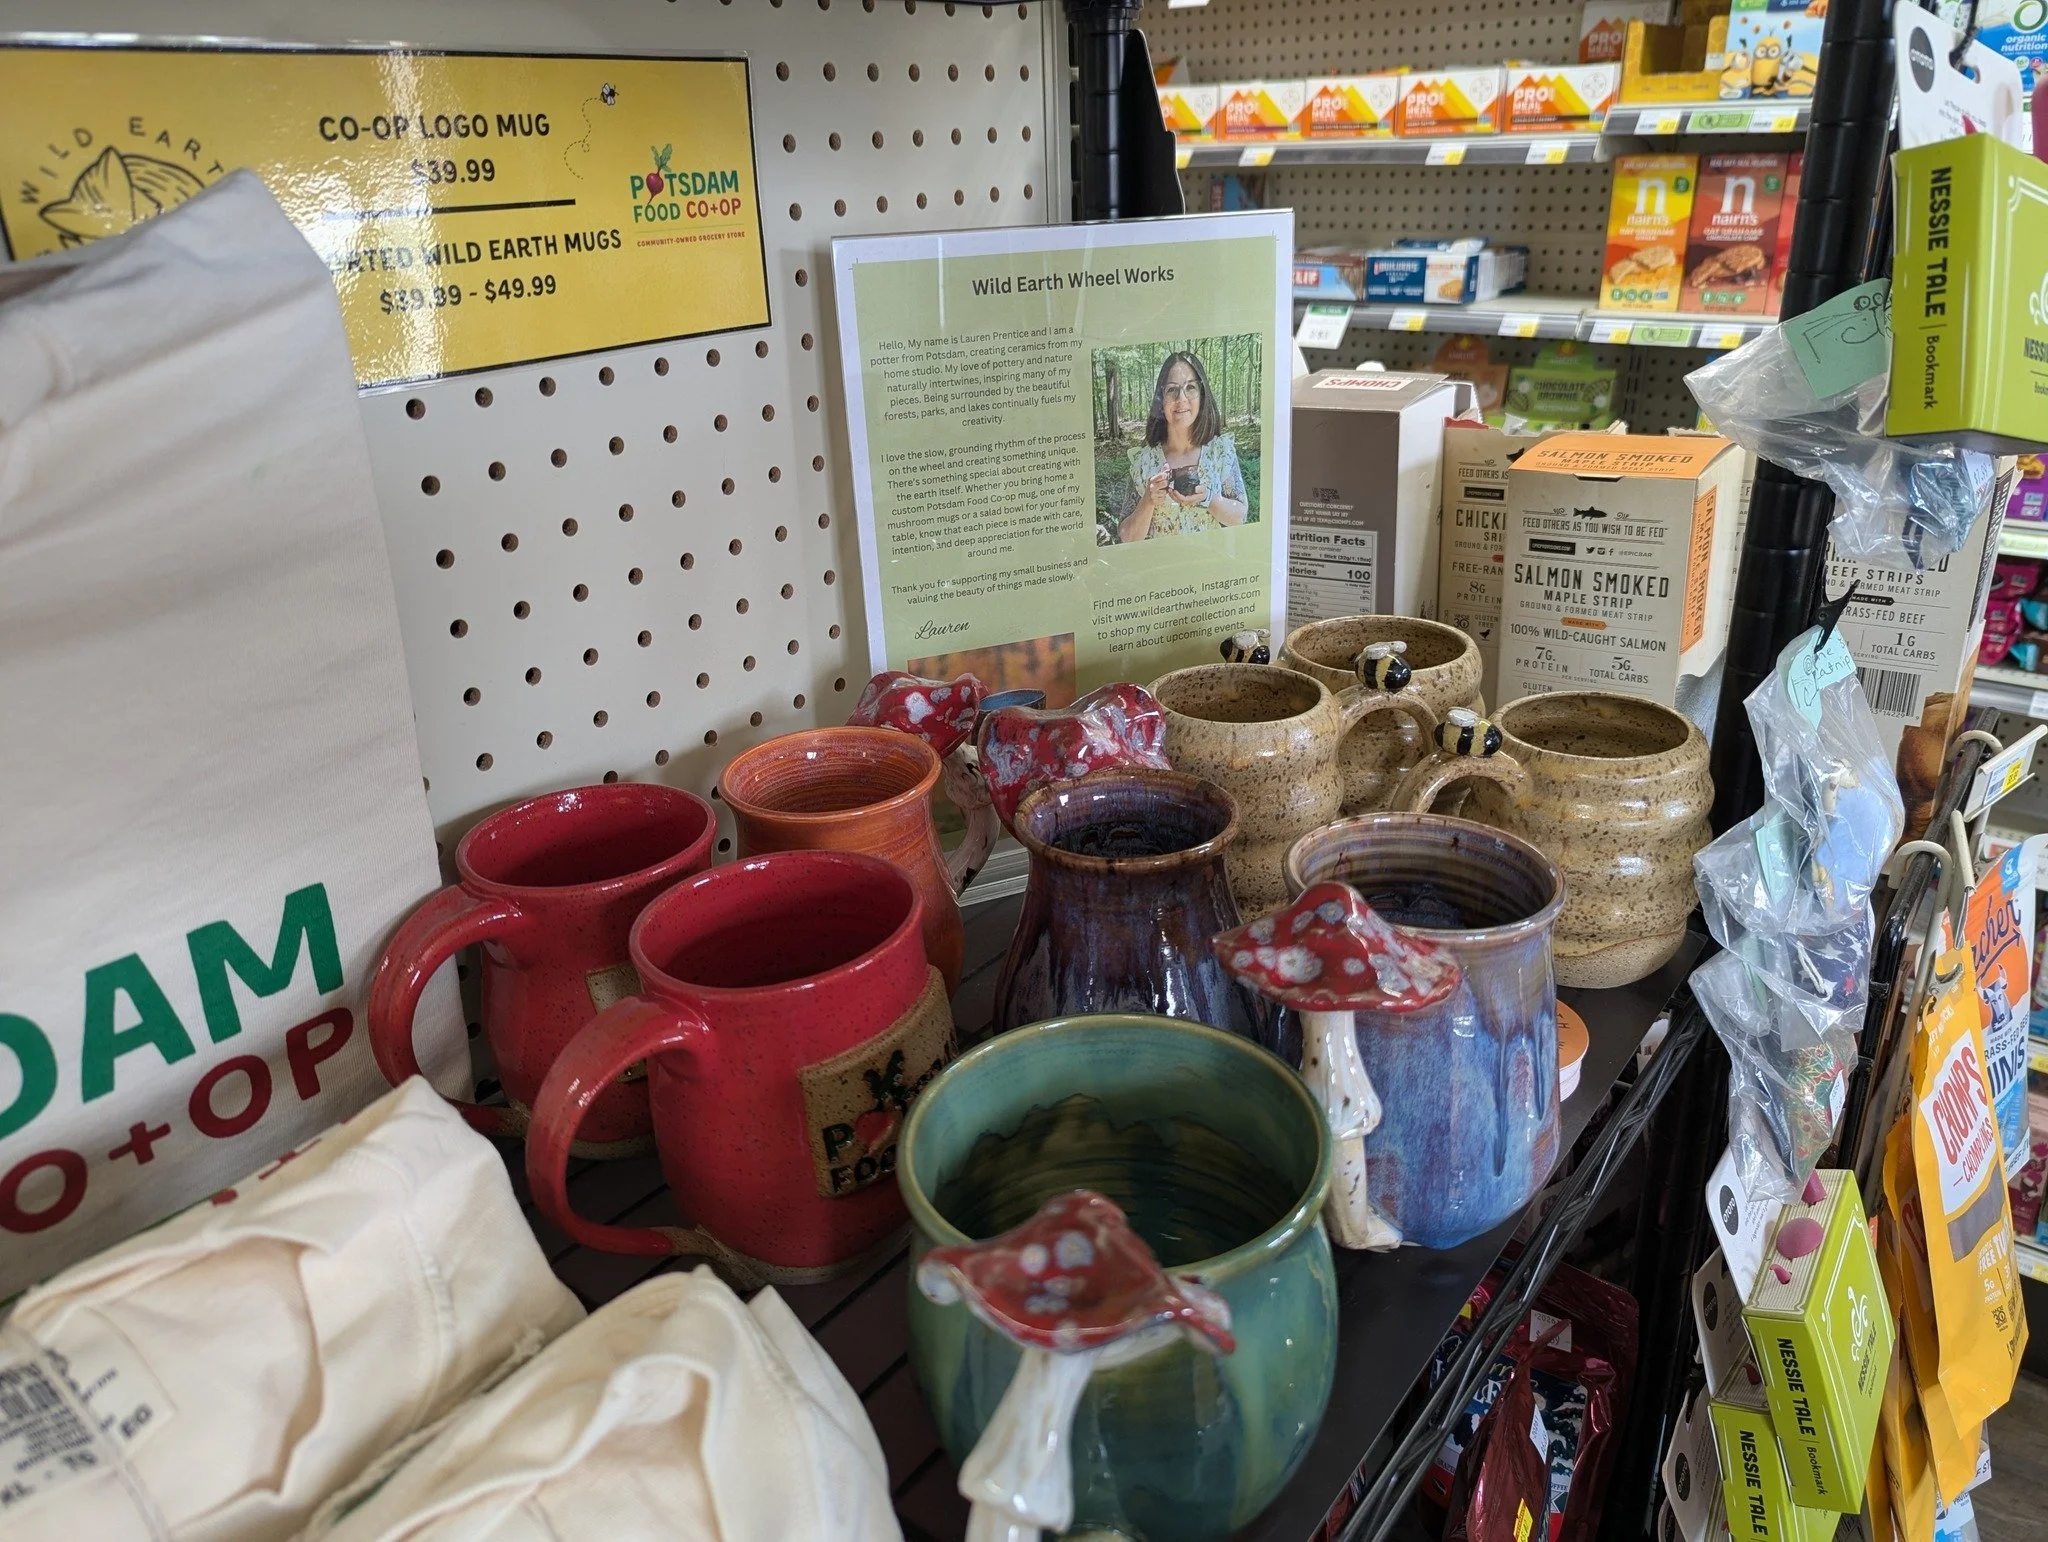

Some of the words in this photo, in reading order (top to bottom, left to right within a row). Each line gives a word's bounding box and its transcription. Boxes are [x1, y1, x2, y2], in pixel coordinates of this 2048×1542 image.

[2001, 42, 2048, 52] nutrition
[2006, 33, 2047, 44] organic
[319, 115, 409, 142] CO-OP
[419, 114, 488, 139] LOGO
[497, 113, 550, 137] MUG
[20, 128, 93, 203] WILD
[411, 158, 495, 185] $39.99
[633, 203, 680, 223] FOOD
[686, 198, 742, 219] CO+OP
[1928, 166, 1952, 251] NESSIE
[424, 242, 482, 266] WILD
[489, 235, 558, 261] EARTH
[564, 228, 622, 254] MUGS
[637, 236, 697, 248] COMMUNITY-OWNED
[698, 233, 725, 242] GROCERY
[726, 231, 745, 239] STORE
[972, 276, 1011, 295] Wild
[1017, 272, 1063, 292] Earth
[1068, 268, 1120, 288] Wheel
[1124, 265, 1174, 284] Works
[1925, 256, 1949, 318] TALE
[380, 284, 461, 315] $39.99
[484, 274, 557, 303] $49.99
[878, 340, 906, 351] Hello,
[907, 338, 922, 350] My
[923, 337, 949, 347] name
[950, 335, 958, 344] is
[959, 334, 990, 344] Lauren
[992, 329, 1029, 340] Prentice
[1030, 326, 1047, 337] and
[1048, 326, 1051, 335] I
[1053, 327, 1067, 335] am
[1068, 326, 1073, 334] a
[870, 356, 899, 368] potter
[901, 353, 923, 363] from
[926, 349, 967, 361] Potsdam,
[970, 345, 1005, 357] creating
[1007, 341, 1046, 353] ceramics
[1047, 340, 1068, 349] from
[1070, 339, 1082, 349] my
[883, 369, 910, 379] home
[911, 365, 942, 376] studio.
[944, 363, 958, 375] My
[960, 362, 979, 372] love
[980, 359, 990, 370] of
[992, 358, 1025, 371] pottery
[1026, 355, 1042, 365] and
[1044, 354, 1072, 363] nature
[1923, 334, 1940, 410] Bookmark
[1537, 450, 1608, 461] SALMON
[1618, 454, 1693, 464] SMOKED
[1458, 468, 1474, 478] FEED
[1476, 468, 1499, 479] OTHERS
[1501, 471, 1509, 480] AS
[1334, 535, 1366, 547] Facts
[1522, 517, 1540, 528] FEED
[1543, 519, 1570, 531] OTHERS
[1573, 521, 1582, 532] AS
[1584, 522, 1598, 533] YOU
[1602, 523, 1620, 535] WISH
[1624, 525, 1633, 536] TO
[1636, 526, 1645, 537] BE
[891, 583, 917, 594] Thank
[919, 582, 935, 593] you
[936, 579, 949, 588] for
[951, 570, 997, 586] supporting
[998, 570, 1012, 579] my
[1013, 565, 1035, 576] small
[1036, 561, 1072, 573] business
[1073, 556, 1088, 567] and
[906, 593, 938, 605] valuing
[939, 591, 954, 600] the
[955, 587, 985, 598] beauty
[986, 583, 995, 593] of
[996, 581, 1022, 591] things
[1024, 576, 1047, 587] made
[1048, 572, 1074, 583] slowly.
[1347, 569, 1371, 580] 100
[1514, 563, 1582, 590] SALMON
[1593, 572, 1669, 598] SMOKED
[1866, 570, 1925, 585] STRIPS
[1093, 597, 1114, 610] Find
[1117, 596, 1132, 606] me
[1134, 594, 1146, 604] on
[1149, 584, 1196, 601] Facebook,
[1202, 576, 1247, 591] Instagram
[1249, 574, 1259, 583] or
[1544, 590, 1586, 604] MAPLE
[1593, 596, 1633, 609] STRIP
[1888, 586, 1911, 595] MEAT
[1914, 588, 1941, 597] STRIP
[1092, 613, 1112, 626] visit
[1114, 589, 1260, 622] www.wildearthwheelworks.com
[1097, 631, 1108, 639] to
[1110, 626, 1134, 638] shop
[1136, 623, 1151, 634] my
[1153, 616, 1188, 630] current
[1190, 608, 1236, 623] collection
[1237, 602, 1255, 615] and
[1520, 601, 1551, 611] GROUND
[1565, 606, 1598, 616] FORMED
[1602, 611, 1623, 619] MEAT
[1627, 613, 1653, 622] STRIP
[1899, 614, 1926, 625] BEEF
[914, 619, 970, 640] Lauren
[1109, 641, 1133, 653] learn
[1136, 635, 1164, 648] about
[1166, 626, 1212, 643] upcoming
[1214, 621, 1247, 634] events
[1511, 624, 1540, 637] 100%
[1543, 627, 1616, 647] WILD-CAUGHT
[1620, 637, 1666, 652] SALMON
[1871, 644, 1900, 656] TOTAL
[1903, 649, 1936, 660] CARBS
[1515, 658, 1568, 673] PROTEIN
[1590, 669, 1615, 681] TOTAL
[1618, 673, 1649, 684] CARBS
[1522, 682, 1553, 692] GLUTEN
[1933, 1046, 1988, 1166] CHOMPS
[1962, 1117, 1994, 1183] CHOMPLINGS
[1776, 1337, 1806, 1394] NESSIE
[1791, 1396, 1816, 1436] TALE
[1806, 1446, 1828, 1496] Bookmark
[1739, 1430, 1762, 1490] NESSIE
[1748, 1494, 1768, 1536] TALE
